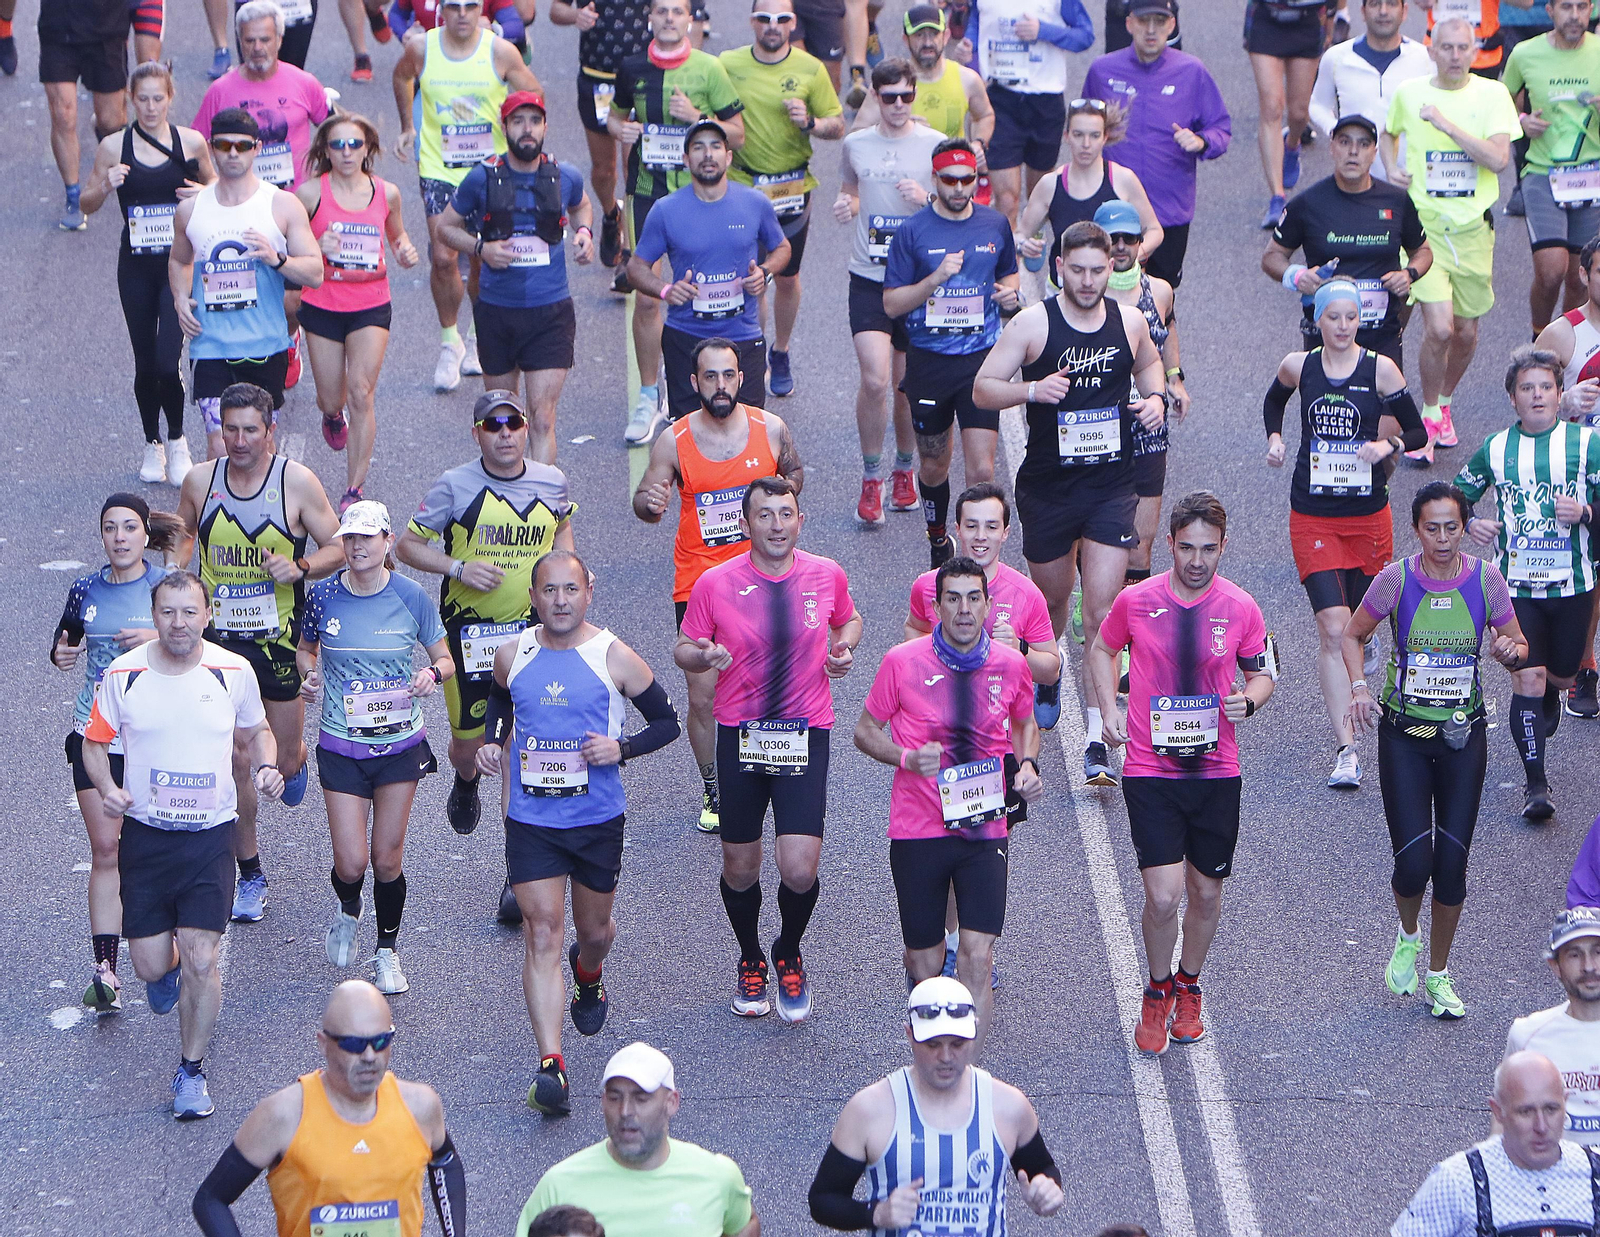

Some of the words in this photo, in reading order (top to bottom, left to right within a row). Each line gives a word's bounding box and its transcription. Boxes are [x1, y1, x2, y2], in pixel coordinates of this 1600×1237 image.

[1550, 78, 1589, 86] RANING
[458, 126, 488, 134] ZURICH
[146, 206, 176, 216] ZURICH
[144, 224, 170, 232] 11002
[344, 224, 376, 236] ZURICH
[342, 242, 363, 251] 8371
[512, 245, 533, 254] 7035
[216, 262, 248, 272] ZURICH
[706, 271, 736, 283] ZURICH
[217, 280, 240, 290] 7544
[1357, 282, 1382, 290] URICH
[708, 290, 730, 299] 6820
[946, 286, 979, 296] ZURICH
[708, 302, 730, 310] BENOIT
[946, 306, 969, 314] 7366
[1074, 377, 1102, 388] AIR
[1314, 404, 1354, 418] LAUFEN
[1078, 412, 1114, 424] ZURICH
[1316, 416, 1353, 428] GEGEN
[1080, 431, 1104, 442] 9595
[1317, 426, 1353, 438] LEIDEN
[1074, 444, 1109, 454] KENDRICK
[1328, 463, 1358, 472] 11625
[718, 510, 742, 522] 7867
[476, 522, 546, 546] TRAILRUN
[1530, 540, 1566, 550] ZURICH
[475, 548, 501, 558] Lucena
[502, 548, 514, 558] del
[1526, 558, 1556, 567] 12732
[236, 570, 248, 578] del
[1528, 572, 1550, 580] MANU
[232, 586, 268, 596] ZURICH
[230, 607, 262, 617] 10132
[226, 620, 266, 628] CRISTÓBAL
[482, 623, 520, 635] ZURICH
[476, 660, 493, 669] JOSE
[1431, 656, 1468, 666] ZURICH
[366, 679, 401, 691] ZURICH
[1426, 676, 1456, 687] 11490
[367, 700, 393, 712] 8352
[1174, 698, 1213, 710] ZURICH
[372, 716, 388, 725] TAM
[762, 720, 801, 731] ZURICH
[1174, 720, 1202, 731] 8544
[1168, 734, 1206, 744] MANCHON
[540, 740, 579, 750] ZURICH
[760, 740, 790, 750] 10306
[740, 752, 770, 762] MANUEL
[772, 754, 808, 764] BAQUERO
[540, 762, 567, 772] 7206
[960, 760, 995, 778] ZURICH
[172, 776, 210, 787] ZURICH
[540, 777, 566, 786] JESUS
[962, 786, 986, 800] 8541
[169, 798, 198, 809] 8282
[966, 802, 984, 812] LOPE
[156, 810, 173, 820] ERIC
[174, 812, 208, 822] ANTOLIN
[340, 1205, 389, 1221] ZURICH
